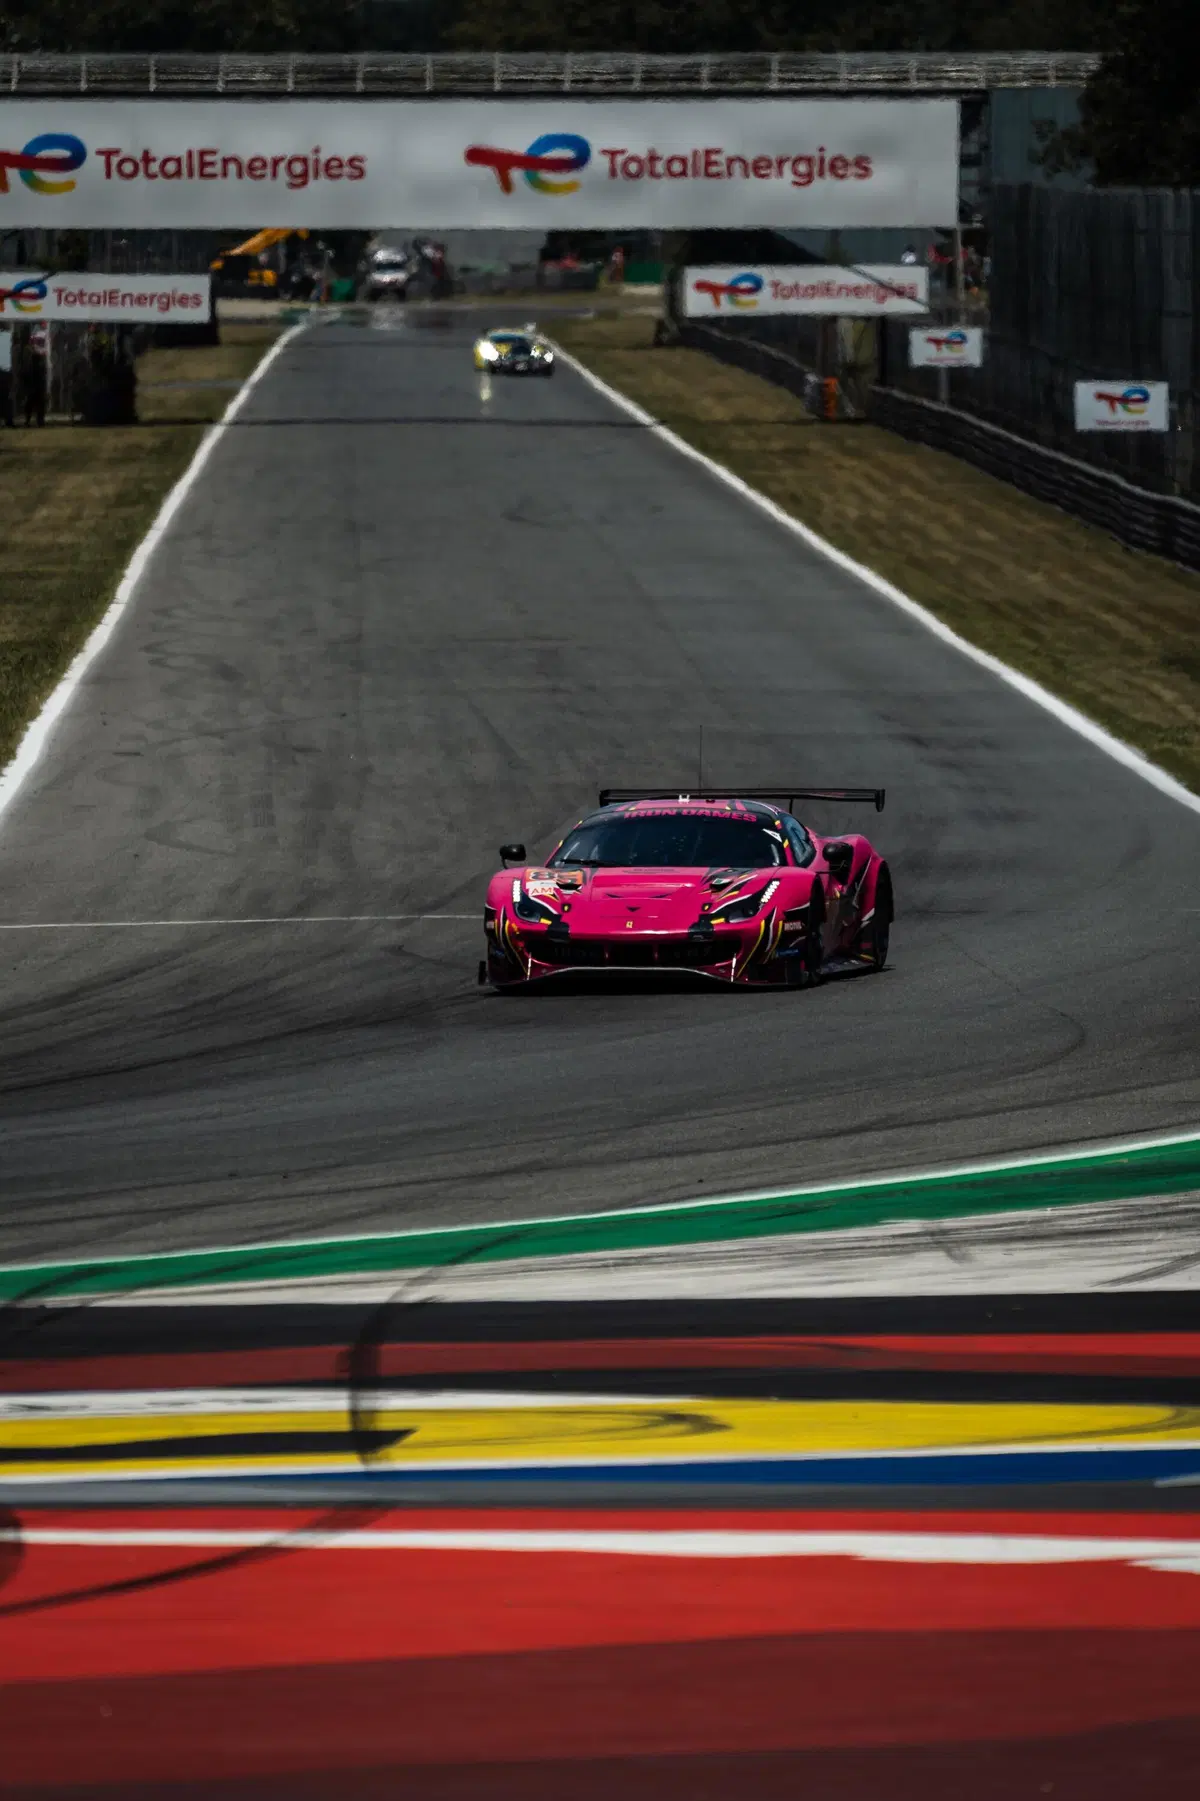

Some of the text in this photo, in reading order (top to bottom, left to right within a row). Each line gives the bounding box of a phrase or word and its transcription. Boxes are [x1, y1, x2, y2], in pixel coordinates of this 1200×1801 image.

[95, 145, 366, 190] TotalEnergies
[599, 146, 873, 188] TotalEnergies
[53, 287, 203, 314] TotalEnergies
[770, 278, 918, 304] TotalEnergies
[624, 809, 757, 822] IRON DAMES
[531, 887, 552, 895] AM
